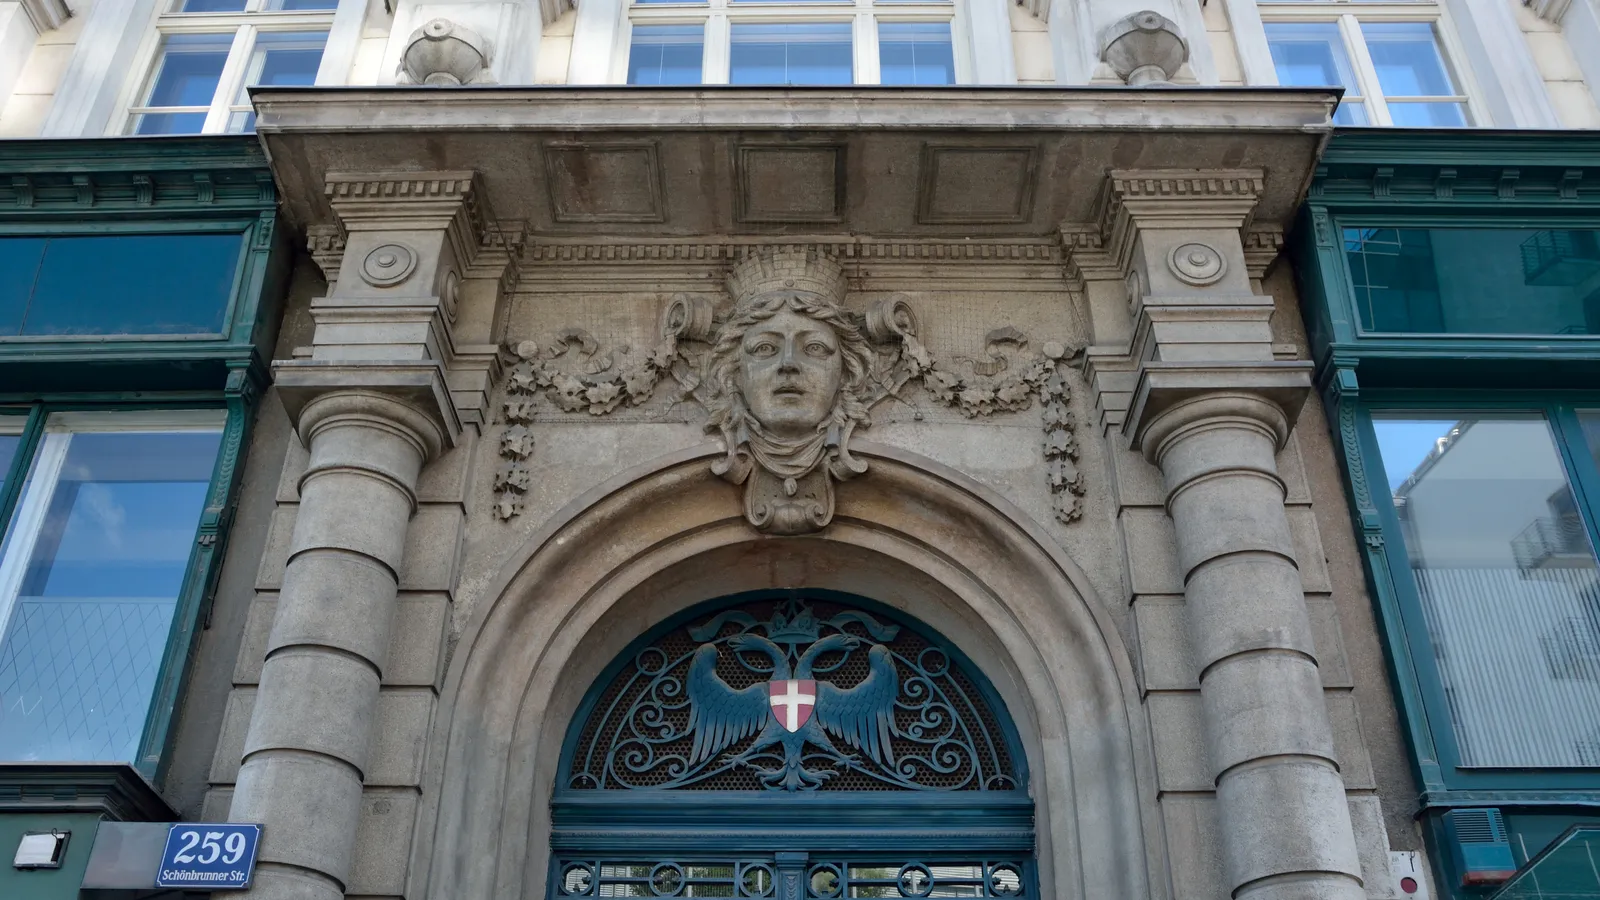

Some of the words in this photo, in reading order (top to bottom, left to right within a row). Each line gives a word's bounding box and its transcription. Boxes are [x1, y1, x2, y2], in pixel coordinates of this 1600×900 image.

[173, 831, 246, 864] 259
[162, 869, 229, 881] Schönbrunner
[229, 870, 245, 881] Str.
